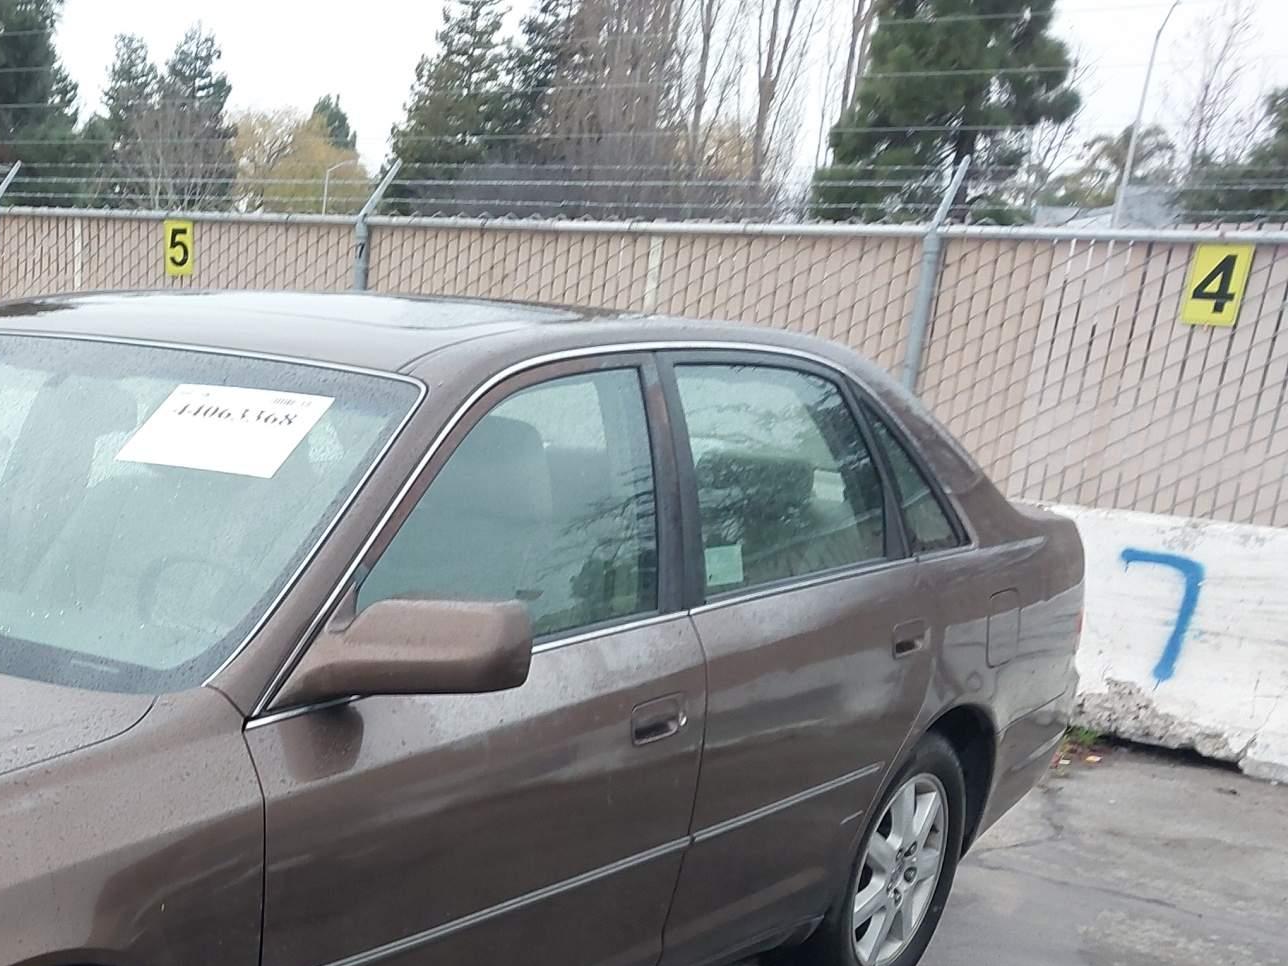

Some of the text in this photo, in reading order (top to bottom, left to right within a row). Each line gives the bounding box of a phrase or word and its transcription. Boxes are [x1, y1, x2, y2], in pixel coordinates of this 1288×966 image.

[169, 227, 189, 267] 5
[1191, 254, 1238, 313] 4
[1120, 548, 1205, 683] 7
